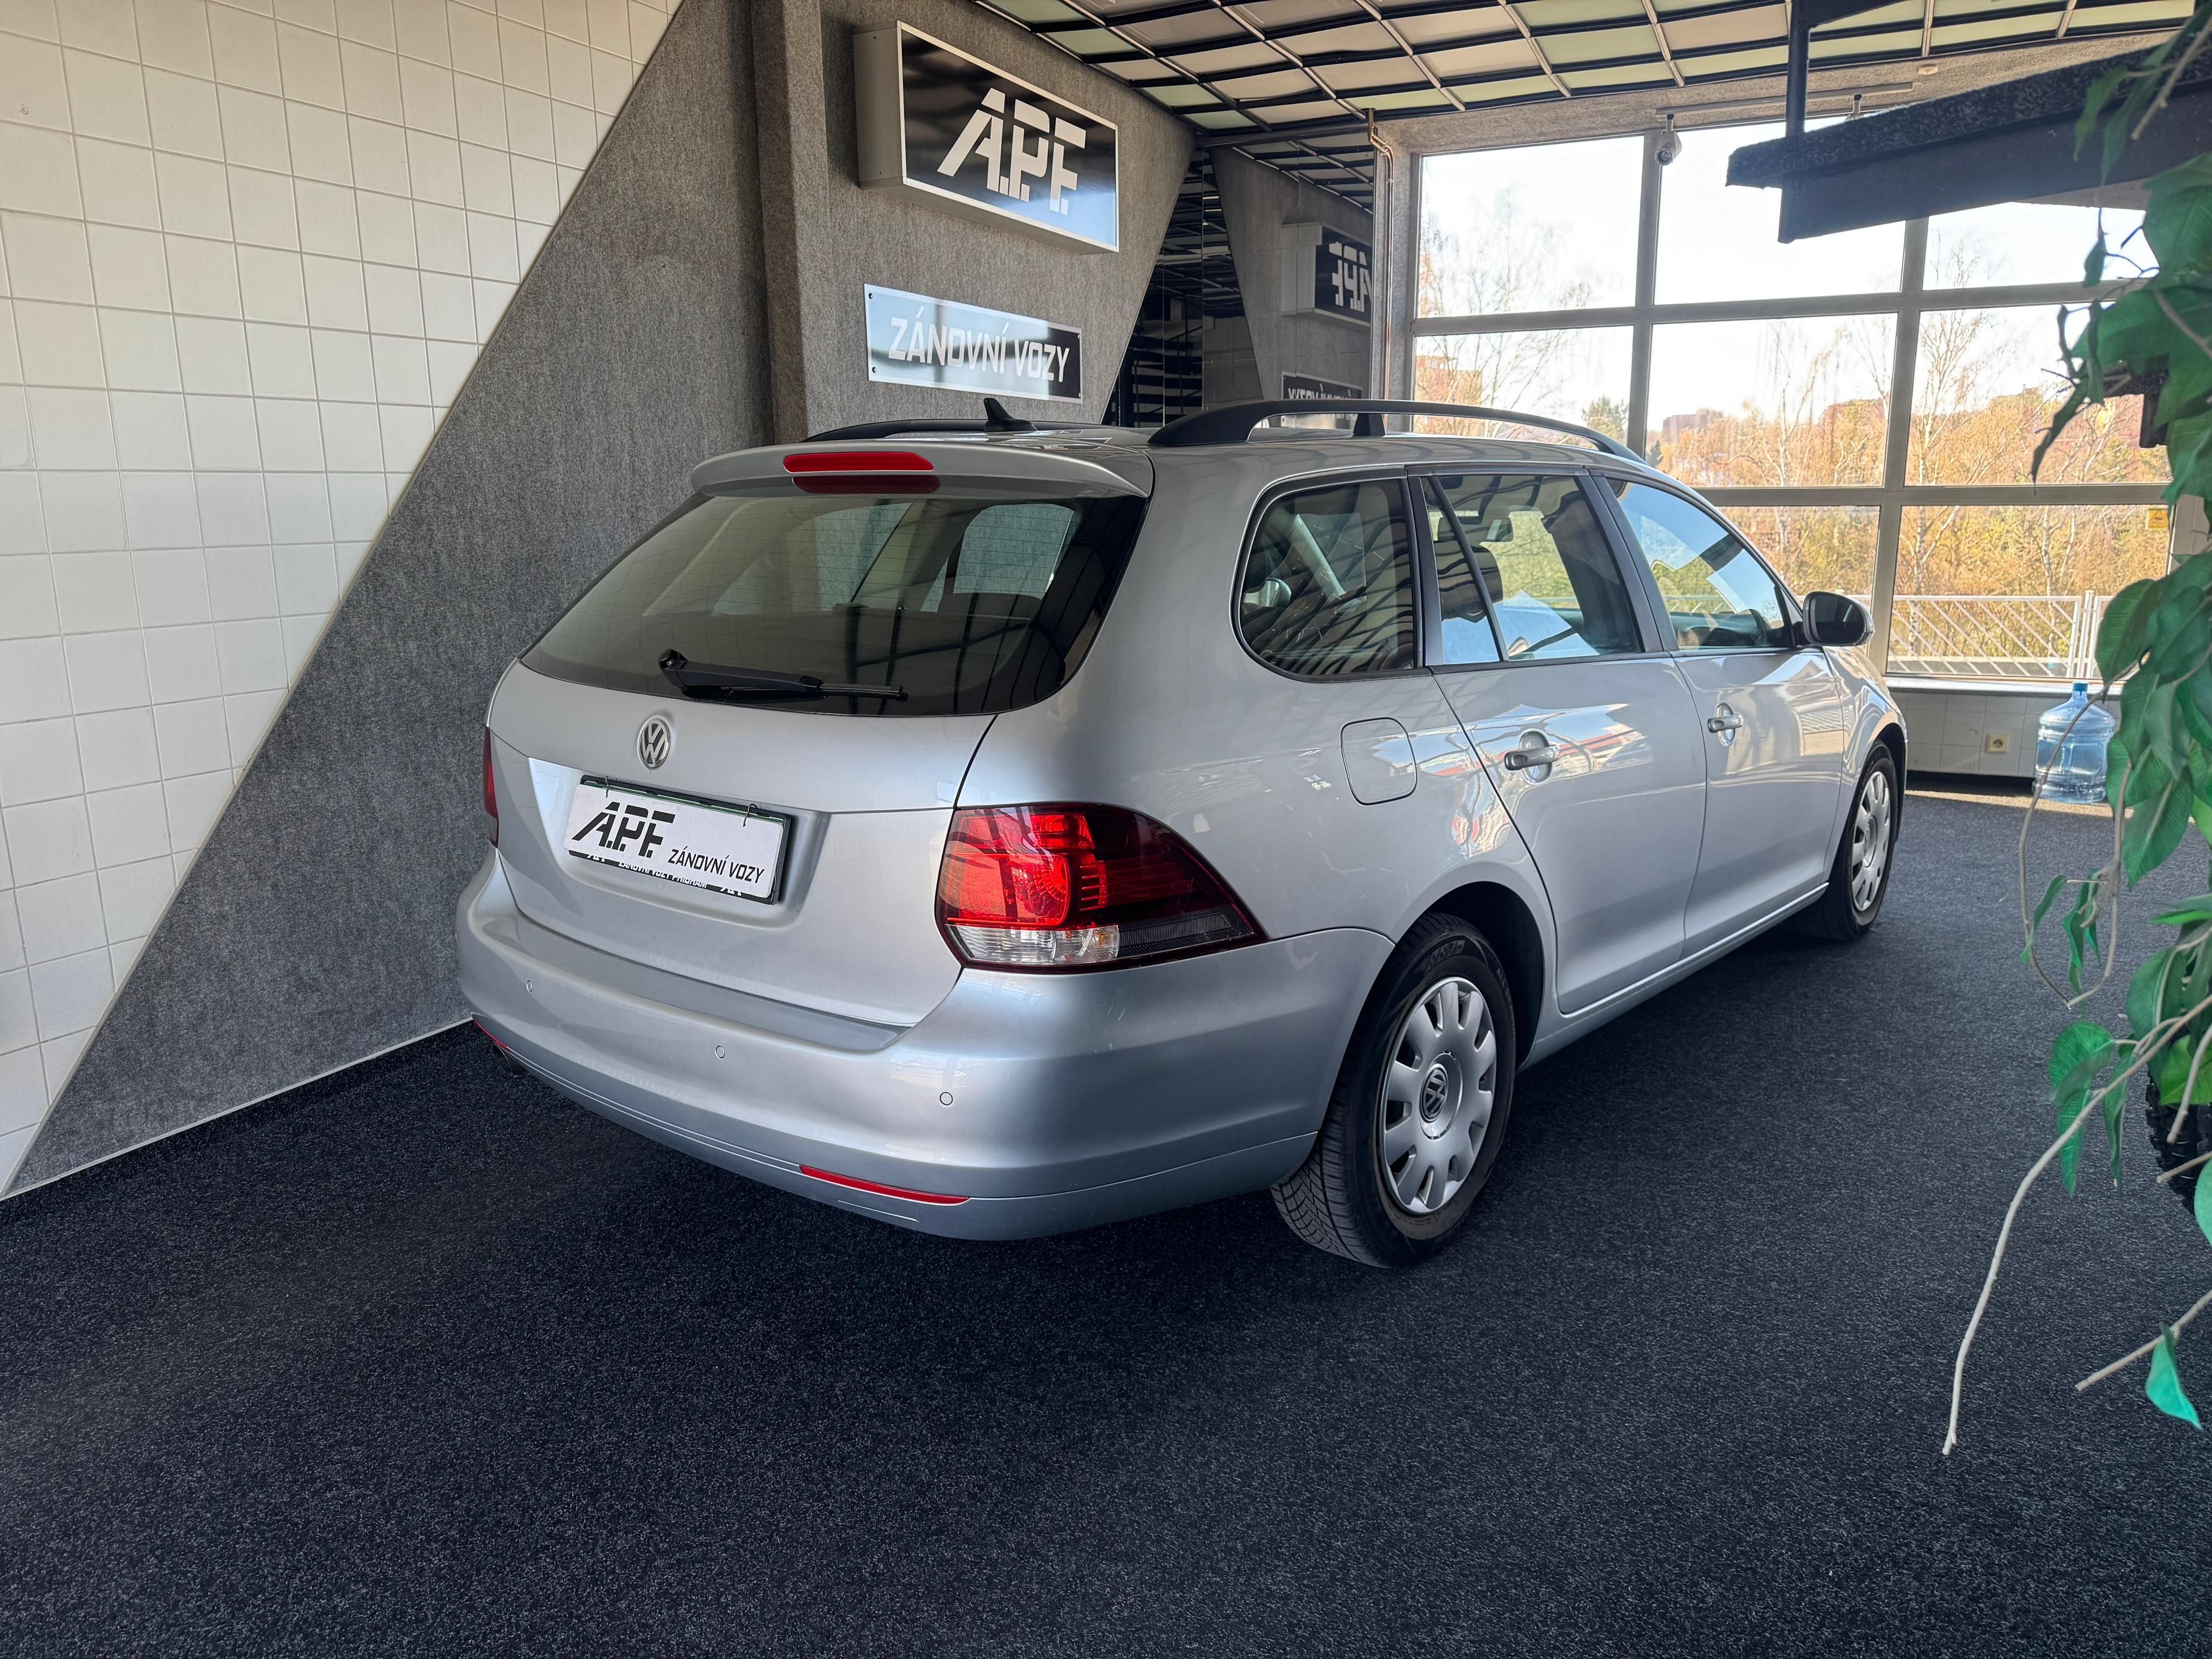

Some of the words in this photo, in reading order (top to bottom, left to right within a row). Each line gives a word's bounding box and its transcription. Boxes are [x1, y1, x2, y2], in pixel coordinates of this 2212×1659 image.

[888, 306, 1010, 374] ZÁNOVNÍ
[1014, 339, 1069, 382] VOZY
[668, 846, 730, 875] ZÁNOVNÍ
[729, 861, 765, 884] VOZY
